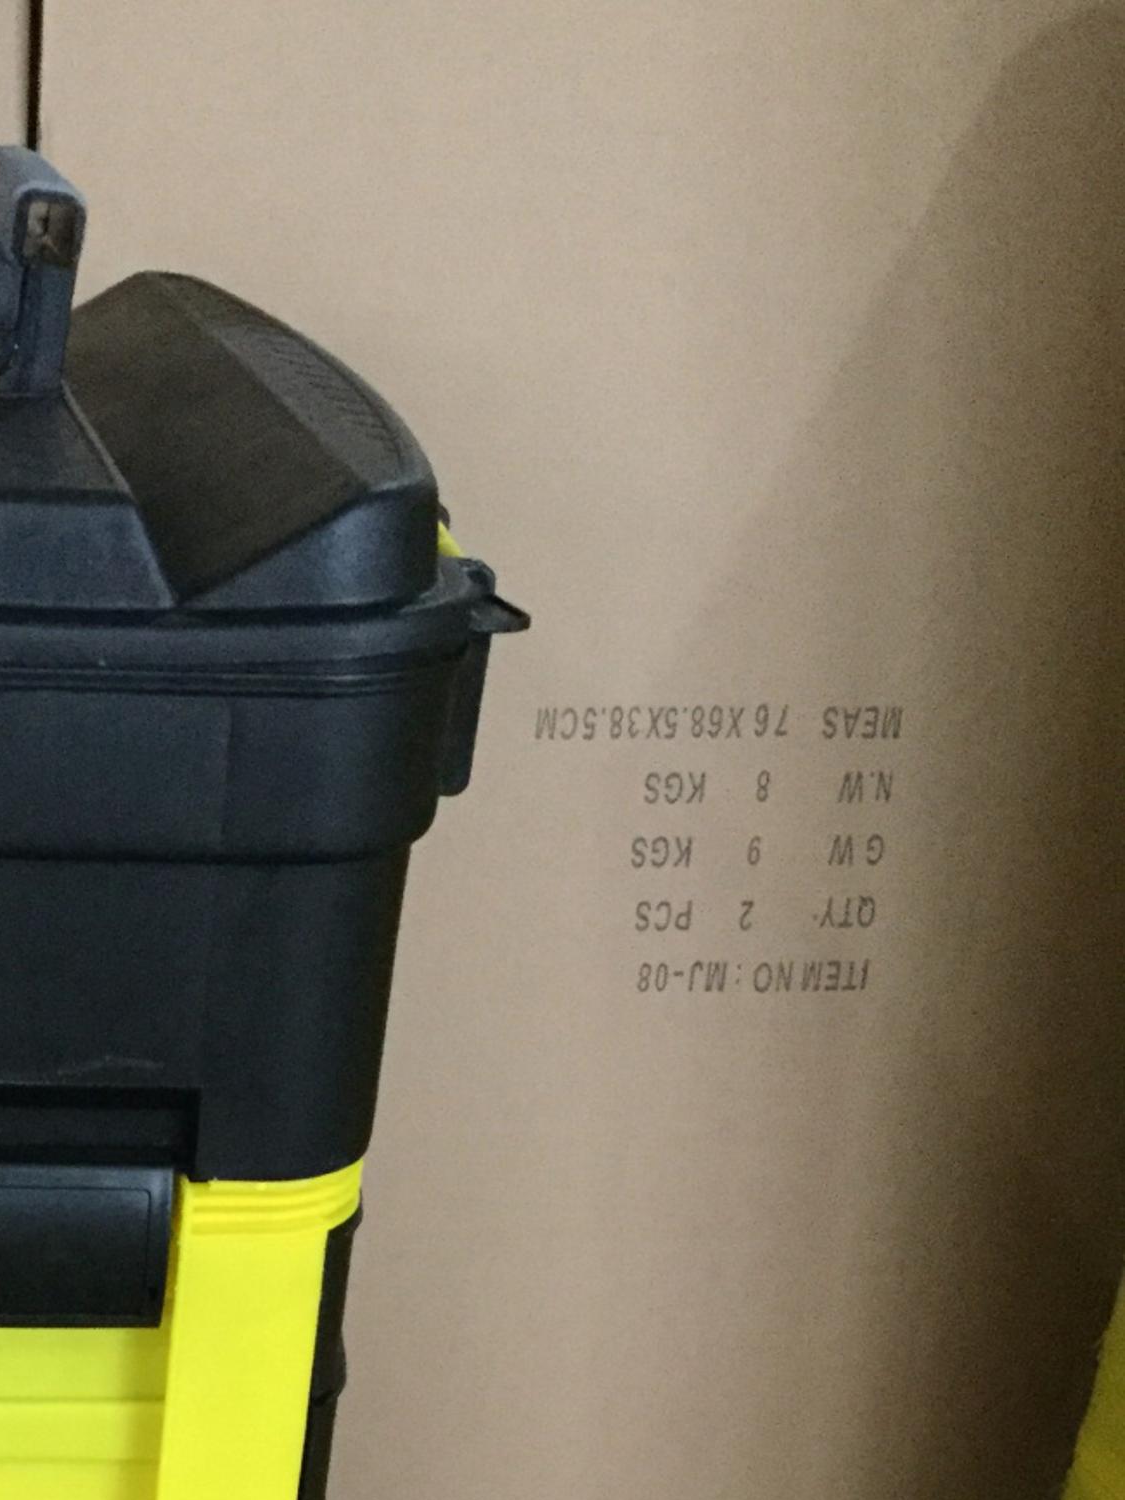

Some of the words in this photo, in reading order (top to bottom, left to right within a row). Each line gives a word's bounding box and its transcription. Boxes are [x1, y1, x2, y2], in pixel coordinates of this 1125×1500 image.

[822, 705, 903, 739] MEAS
[644, 772, 706, 804] KGS
[756, 769, 770, 802] 8
[631, 836, 692, 868] KGS
[747, 835, 762, 866] 9
[635, 900, 692, 932] PCS
[739, 900, 754, 931] 2
[800, 958, 870, 992] ITEM
